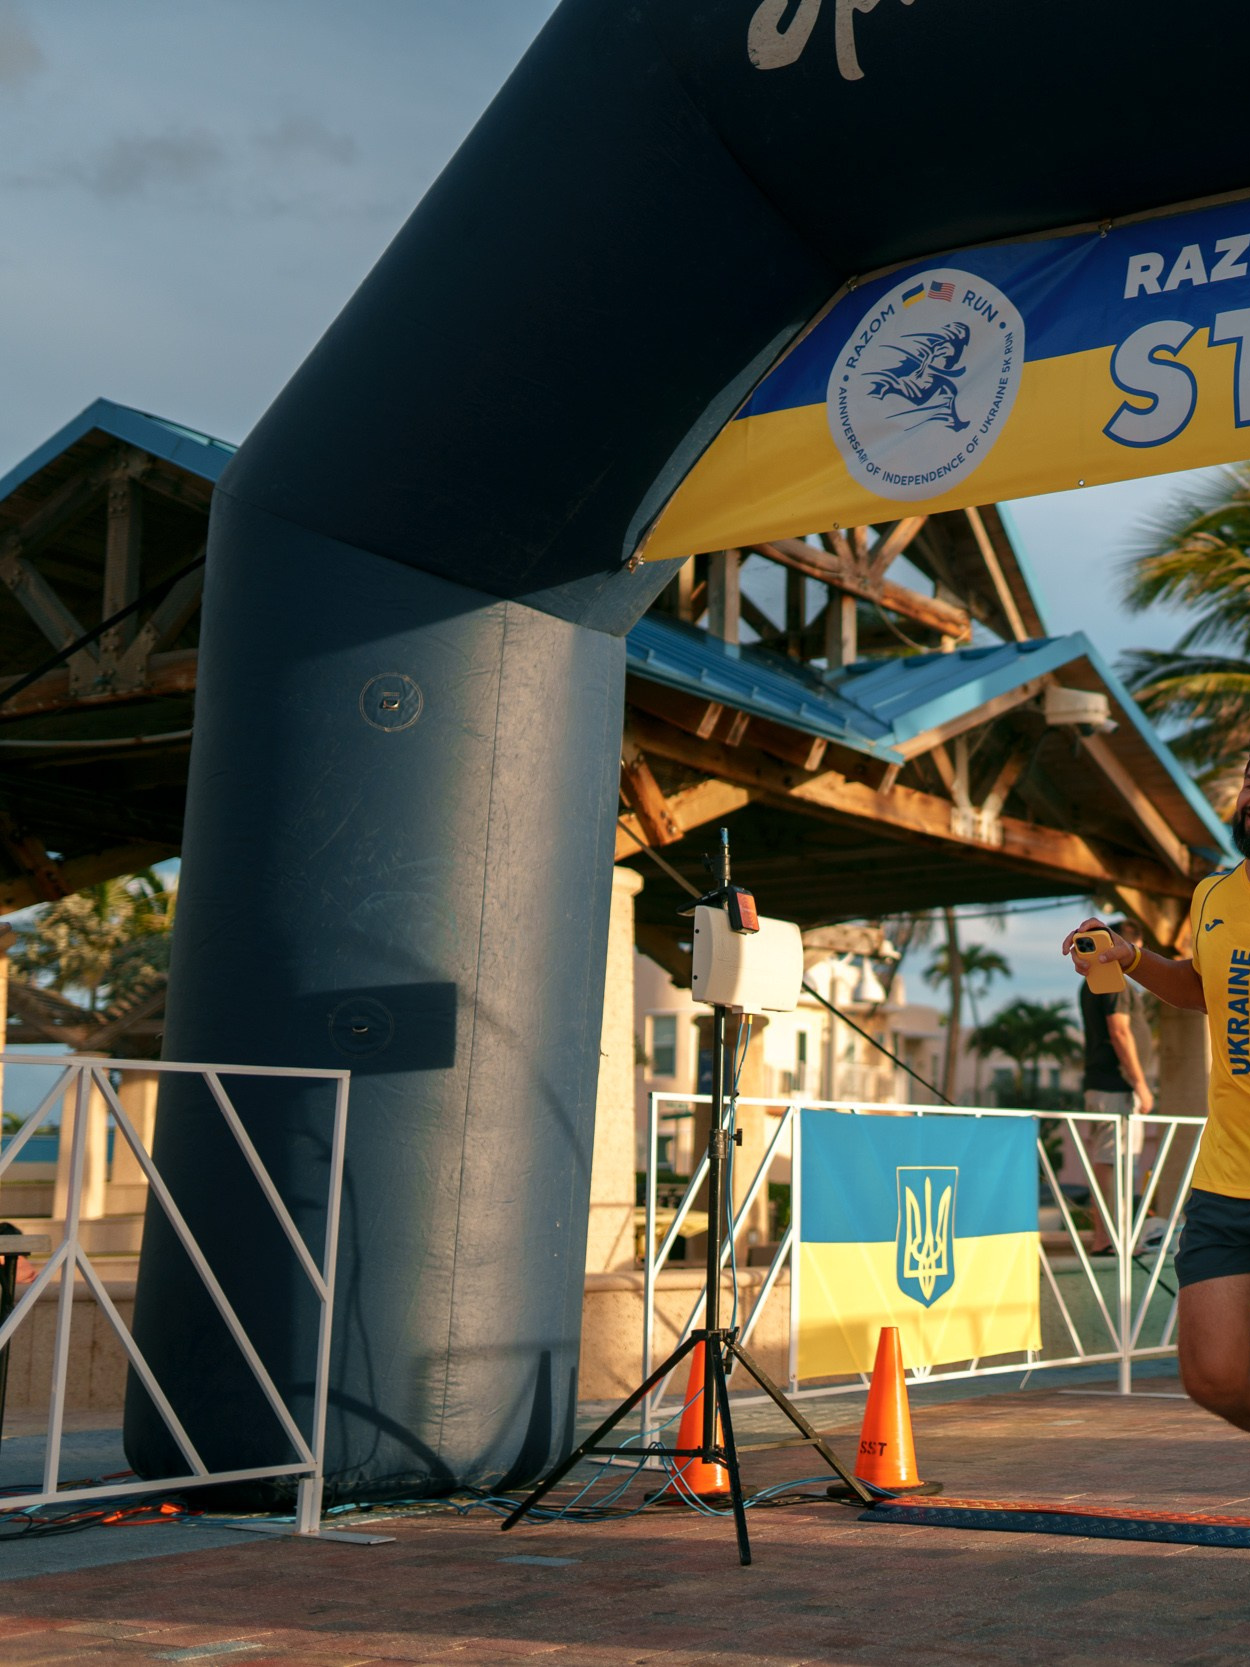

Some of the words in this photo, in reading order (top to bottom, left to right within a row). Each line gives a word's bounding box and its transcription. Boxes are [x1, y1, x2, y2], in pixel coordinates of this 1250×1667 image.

[846, 303, 896, 369] RAZOM
[962, 289, 999, 324] RUN
[1004, 331, 1014, 357] RUN
[1002, 358, 1012, 373] 5K
[979, 377, 1009, 435] UKRAINE
[966, 435, 980, 454] OF
[866, 461, 882, 476] OF
[882, 452, 966, 486] INDEPENDENCE
[860, 1441, 887, 1456] SST
